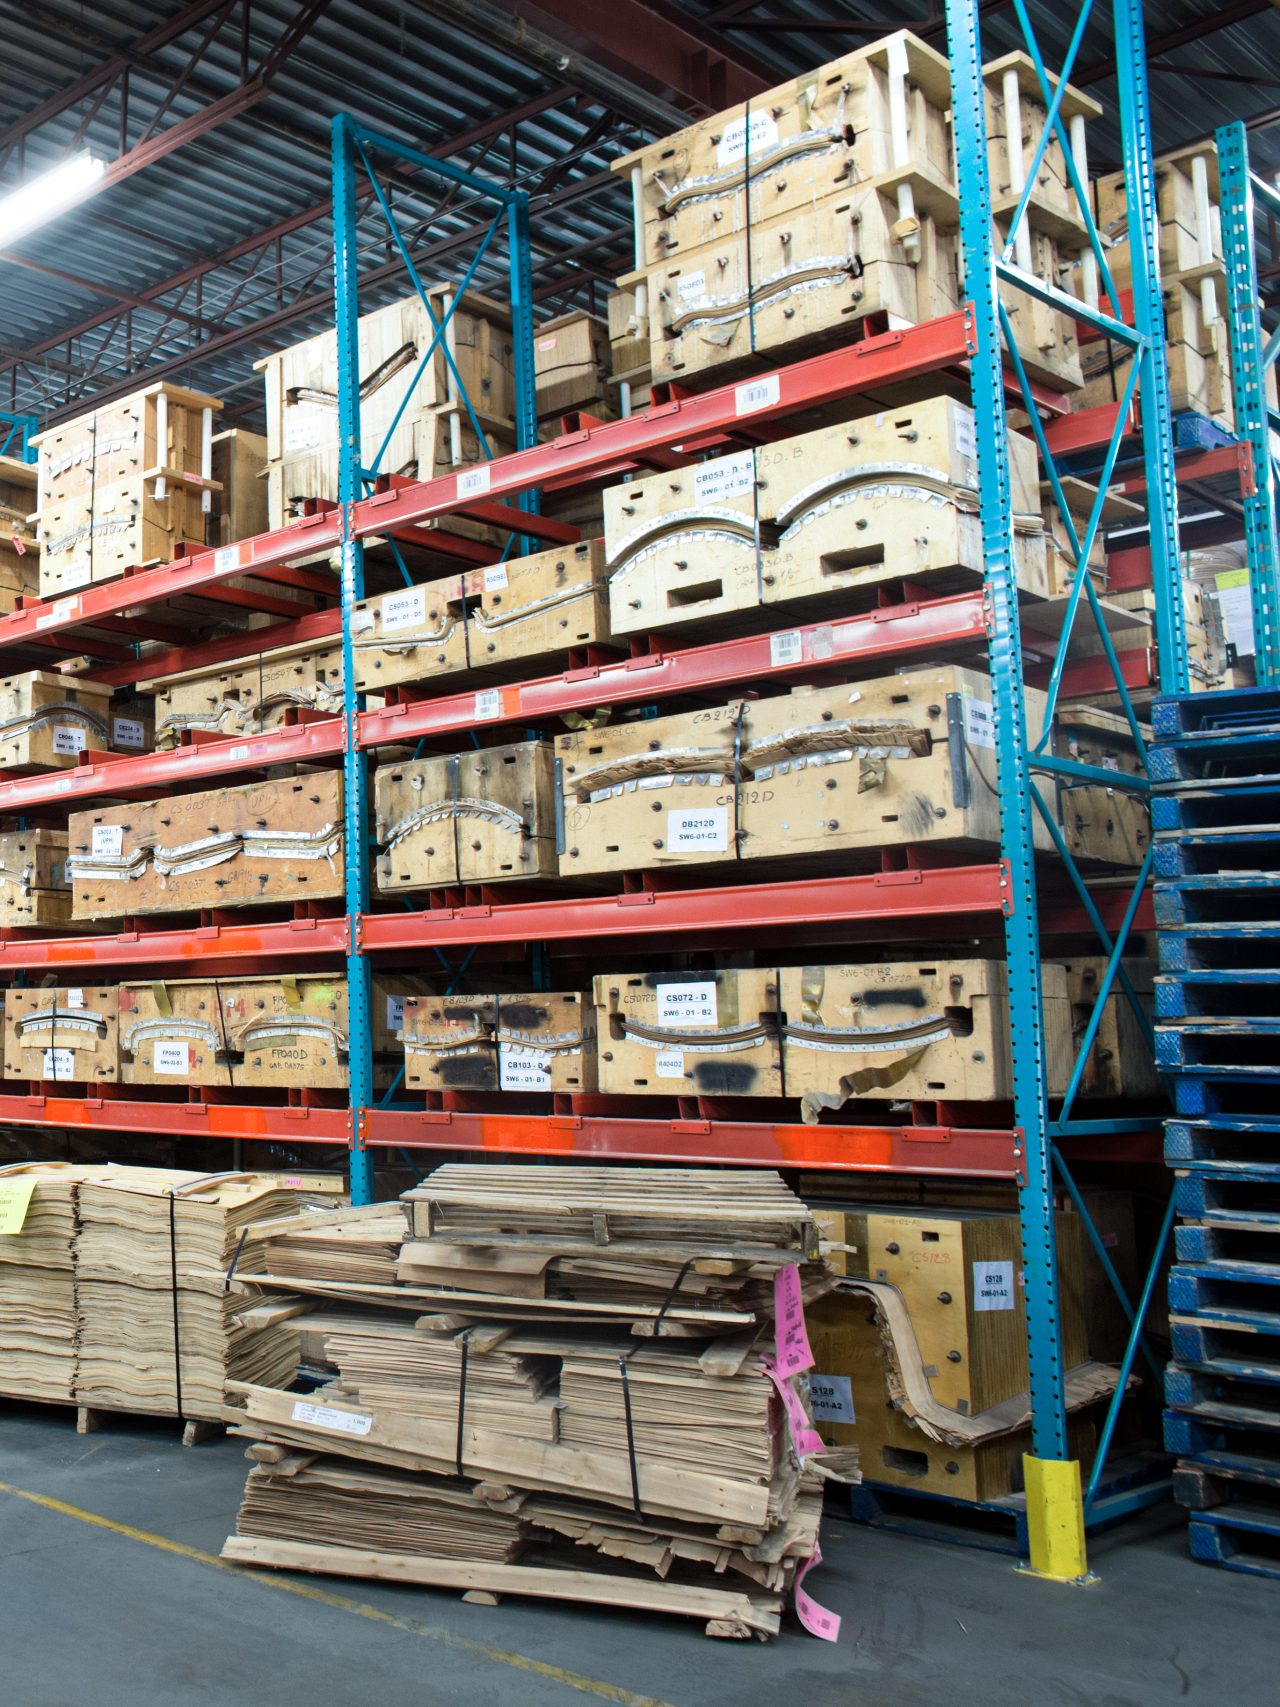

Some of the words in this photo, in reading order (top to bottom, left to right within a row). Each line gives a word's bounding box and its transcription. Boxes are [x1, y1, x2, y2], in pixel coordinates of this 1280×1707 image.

[696, 471, 725, 484] CB053
[746, 462, 752, 470] B
[682, 820, 715, 828] DB212D
[666, 994, 694, 1002] CS072
[985, 1275, 1003, 1283] CS128
[980, 1289, 1008, 1297] SW6-01-A2
[811, 1387, 835, 1395] S128
